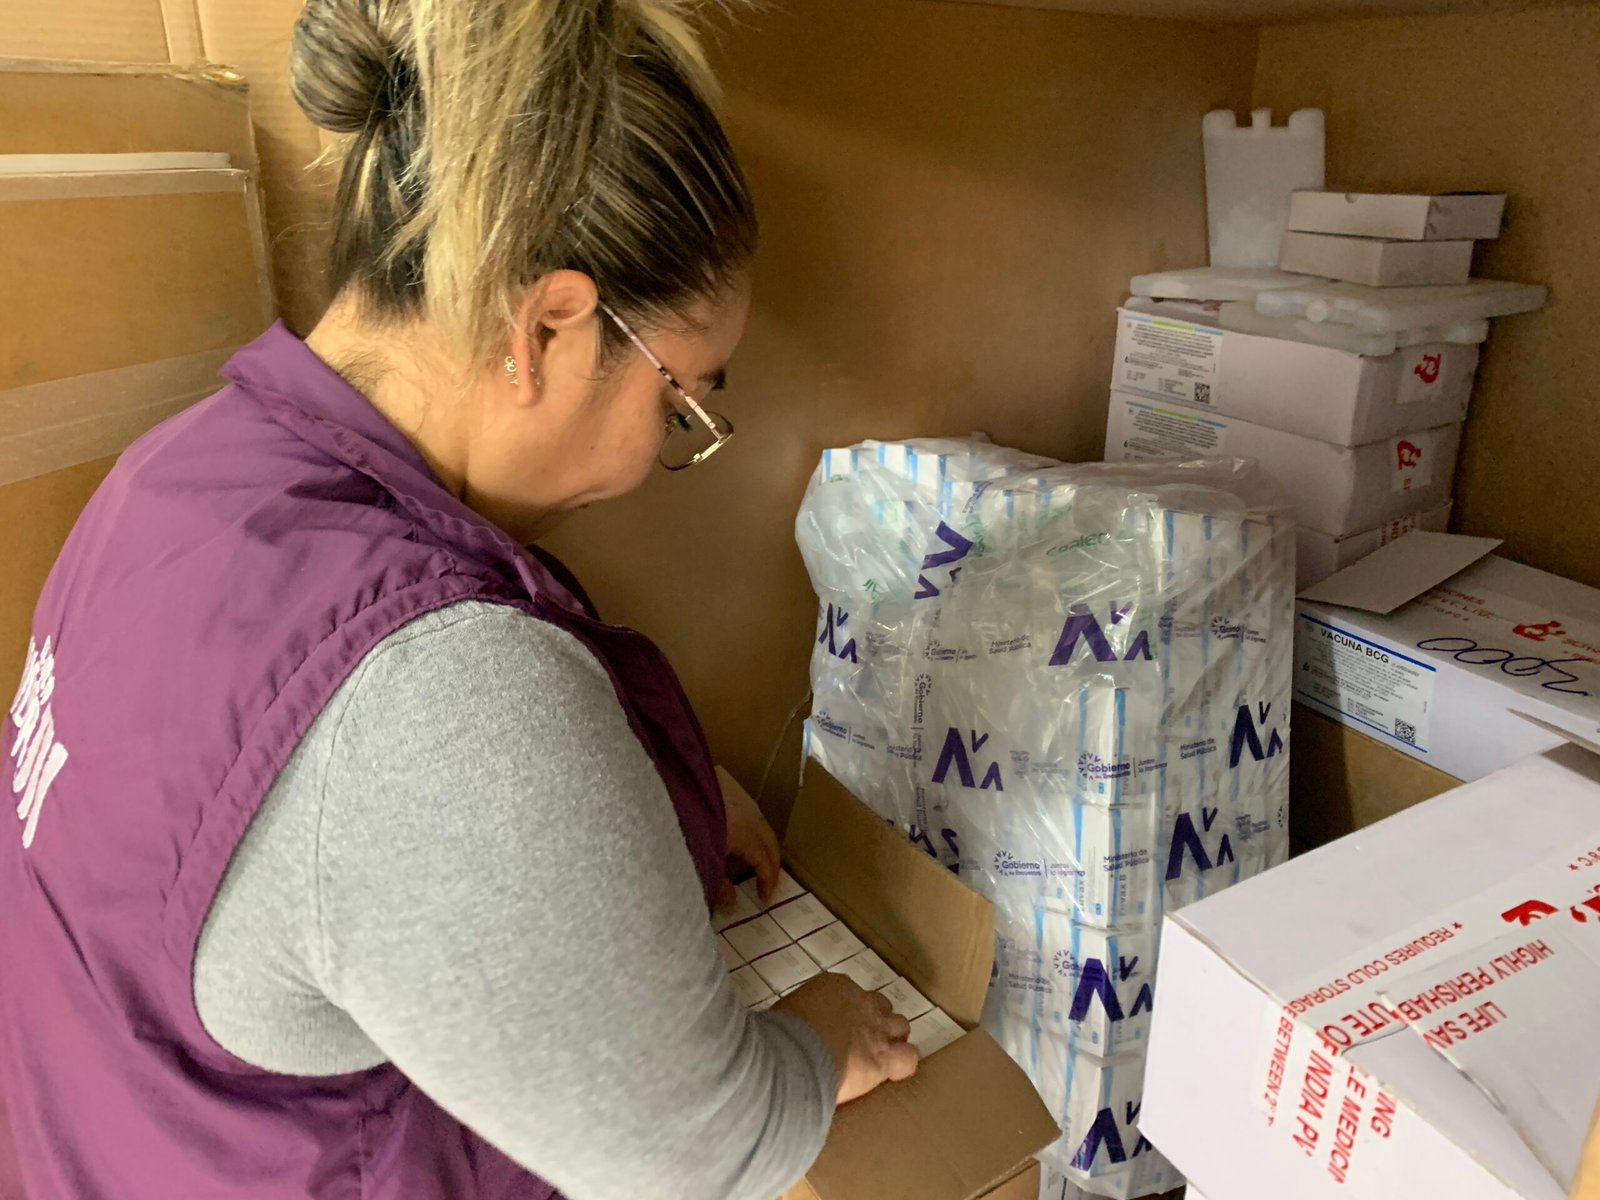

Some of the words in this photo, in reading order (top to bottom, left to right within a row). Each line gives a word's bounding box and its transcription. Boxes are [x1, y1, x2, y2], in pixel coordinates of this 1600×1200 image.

[1320, 628, 1363, 653] VACUNA
[1365, 647, 1390, 664] BCG
[1001, 860, 1041, 870] Gobierno
[1384, 927, 1455, 966] REQUIRES
[1488, 939, 1556, 980] HIGHLY
[1347, 959, 1389, 985] COLD
[1283, 978, 1352, 1019] STORAGE
[1397, 966, 1496, 1022] PERISHAB
[1341, 1002, 1400, 1037] UTE
[1458, 1001, 1508, 1034] LIFE
[1267, 1016, 1294, 1096] BETWEEN
[1316, 1024, 1352, 1057] OF
[1299, 1048, 1334, 1120] INDIA
